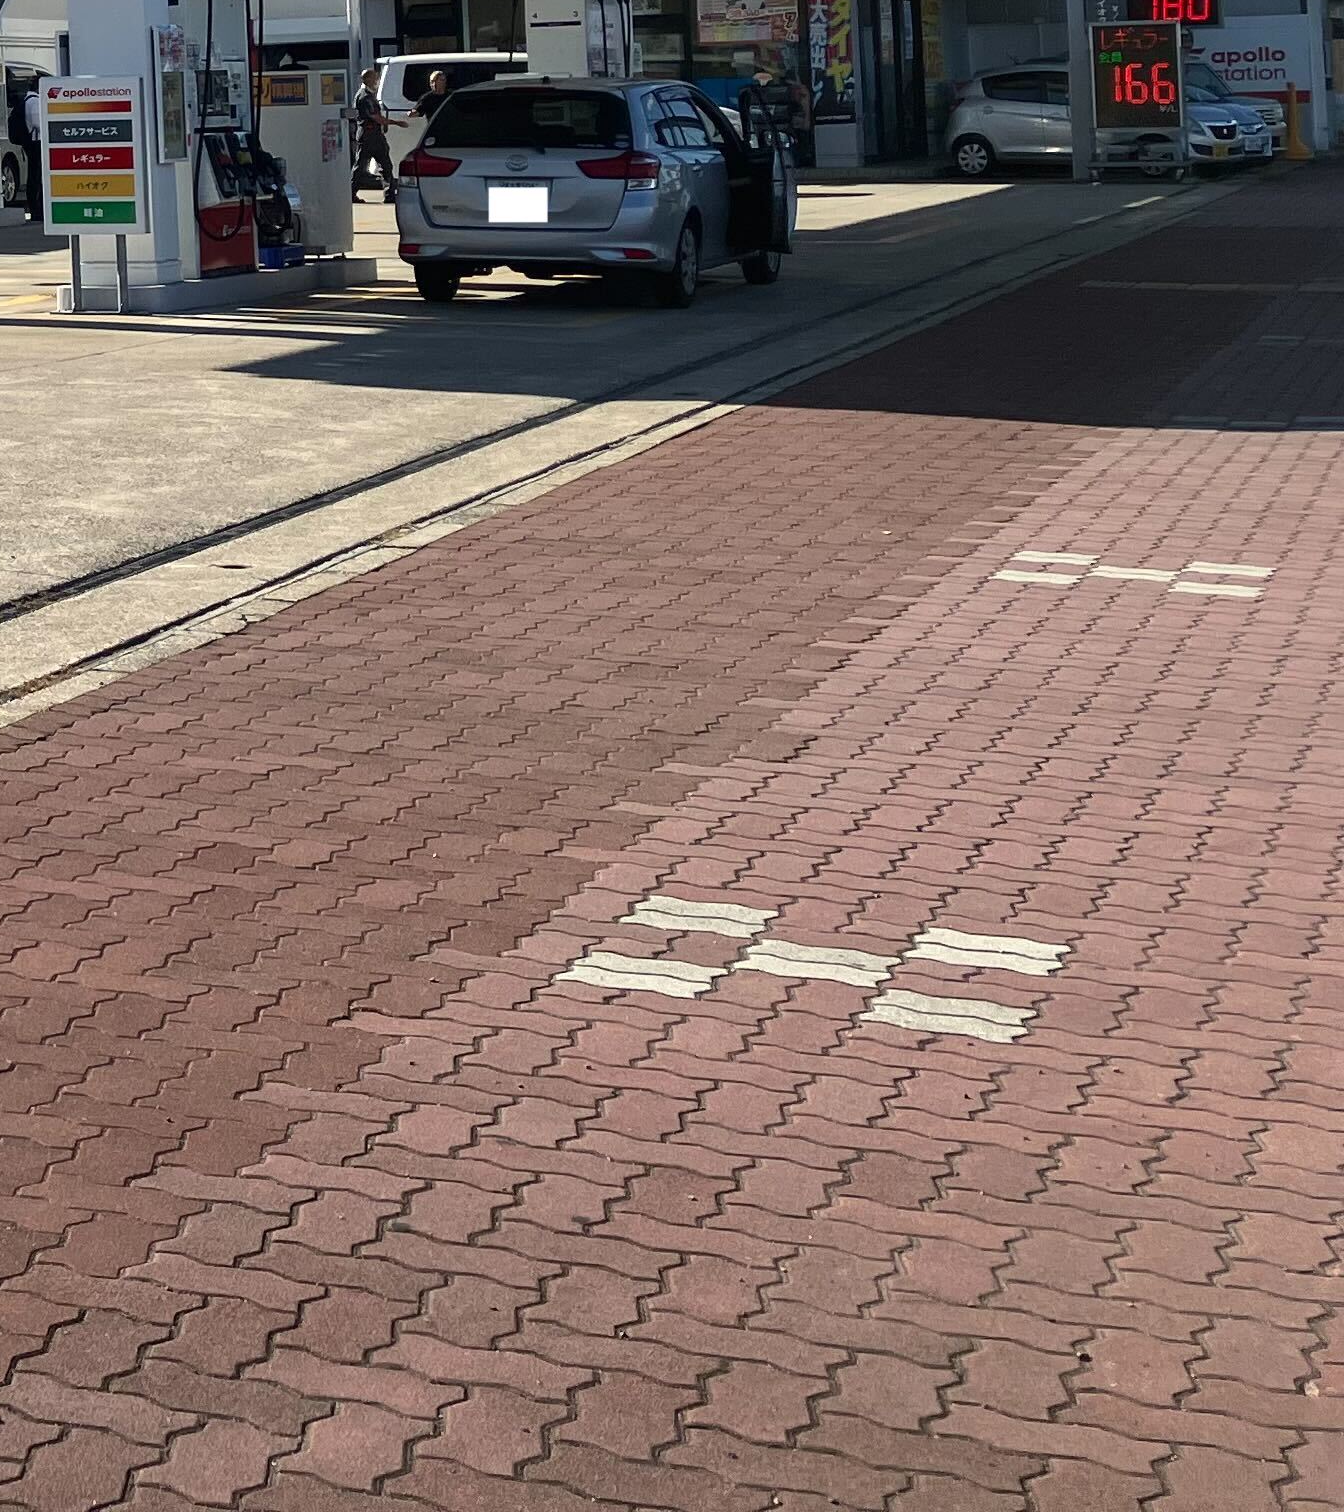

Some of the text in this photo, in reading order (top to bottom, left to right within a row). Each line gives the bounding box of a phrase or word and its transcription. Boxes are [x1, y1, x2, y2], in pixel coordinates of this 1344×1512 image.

[1100, 27, 1169, 51] レギュラー
[1211, 46, 1286, 66] apollo
[1114, 63, 1175, 105] 166
[62, 87, 132, 99] apollostation
[62, 126, 119, 137] セルフサービス
[72, 153, 111, 164] レギュラー
[76, 181, 109, 191] ハイオク
